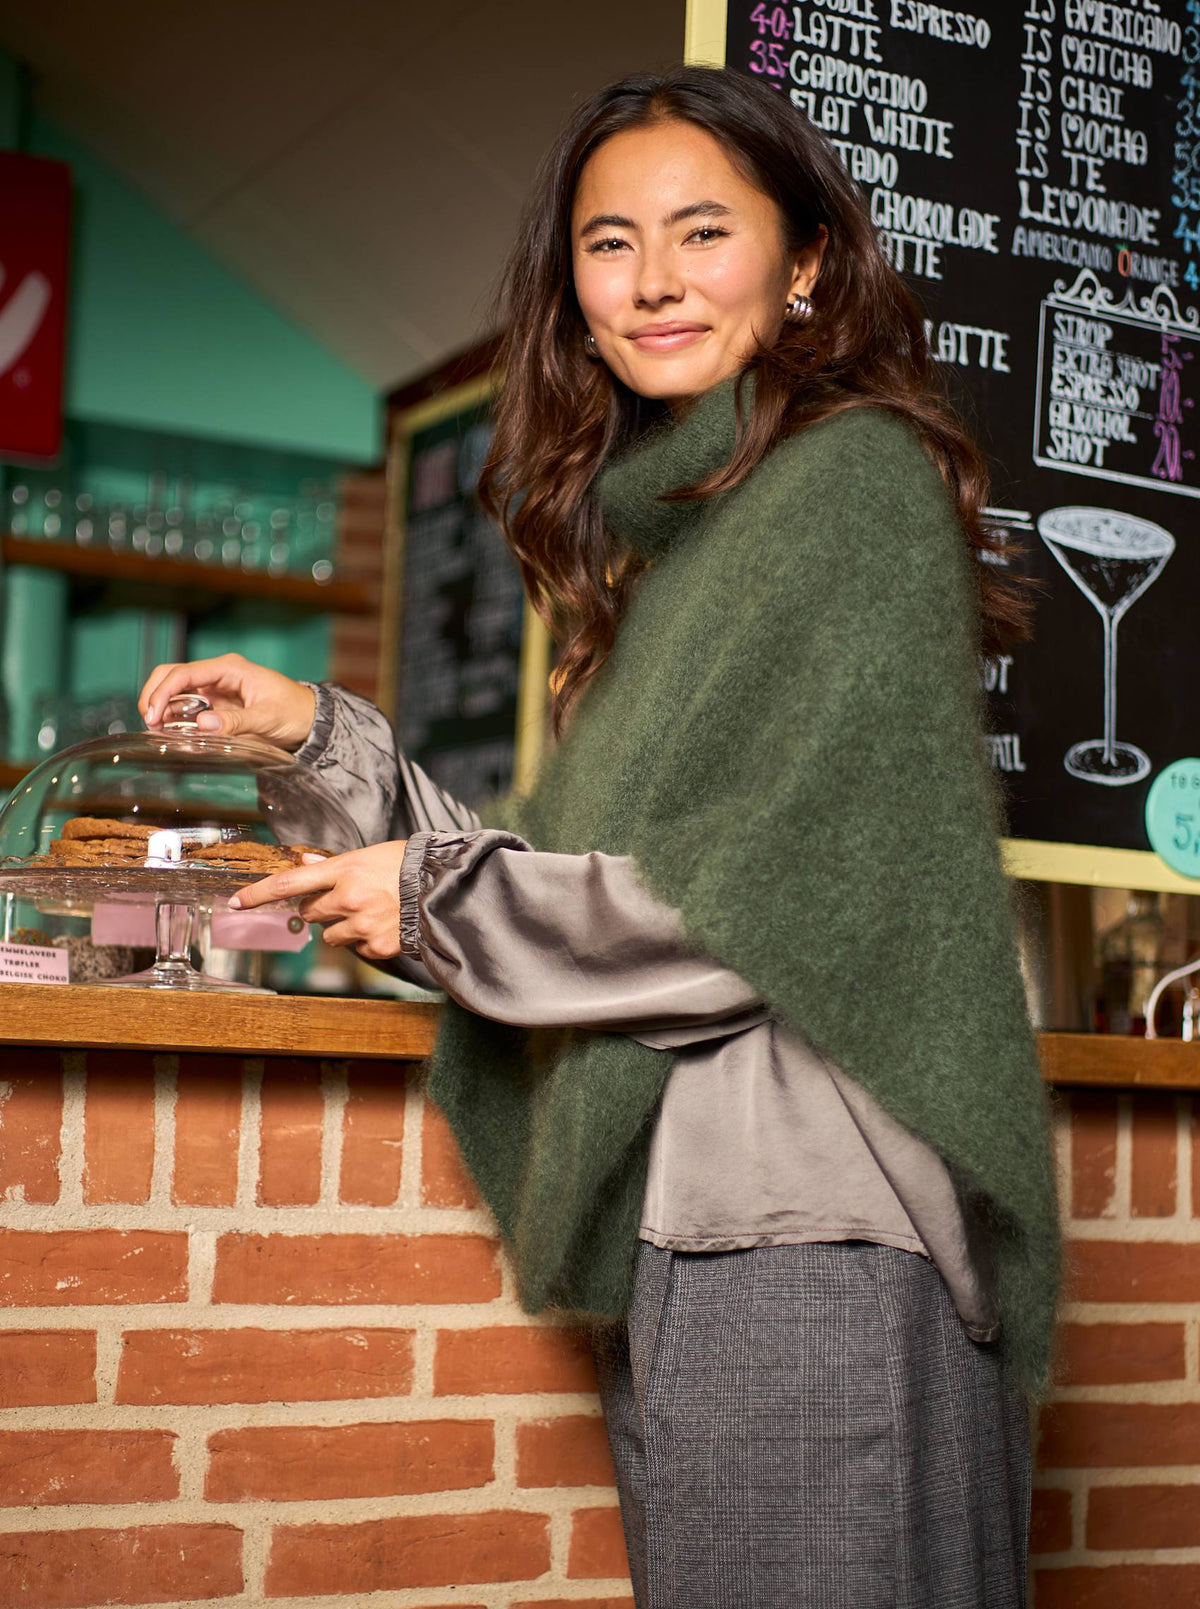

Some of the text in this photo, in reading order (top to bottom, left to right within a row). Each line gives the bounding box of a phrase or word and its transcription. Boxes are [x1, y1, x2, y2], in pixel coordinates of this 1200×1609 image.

[792, 6, 883, 63] LATTE
[889, 0, 991, 49] ESPRESSO
[1023, 0, 1056, 23] IS
[1064, 0, 1182, 56] AMERICANO
[1021, 23, 1053, 63] IS
[1061, 33, 1153, 90] MATCHA
[1019, 63, 1052, 103] IS
[1060, 74, 1126, 121] CHAI
[789, 88, 954, 159] FLAT WHITE
[1016, 100, 1051, 141] IS
[1060, 112, 1148, 166] MOCHA
[830, 138, 899, 188] TADO
[1015, 137, 1049, 179] IS
[1061, 150, 1107, 194] TE
[870, 187, 1001, 254] CHOKOLADE
[1018, 179, 1162, 247] LEMONADE
[876, 230, 944, 280] ATTE
[1010, 225, 1113, 272] AMERICANO
[1117, 245, 1180, 288] ORANGE
[1051, 367, 1140, 412] ESPRESSO
[1053, 342, 1162, 391] EXTRA SHOT
[1046, 428, 1111, 467] SHOT
[1049, 399, 1138, 444] ALKOHOL
